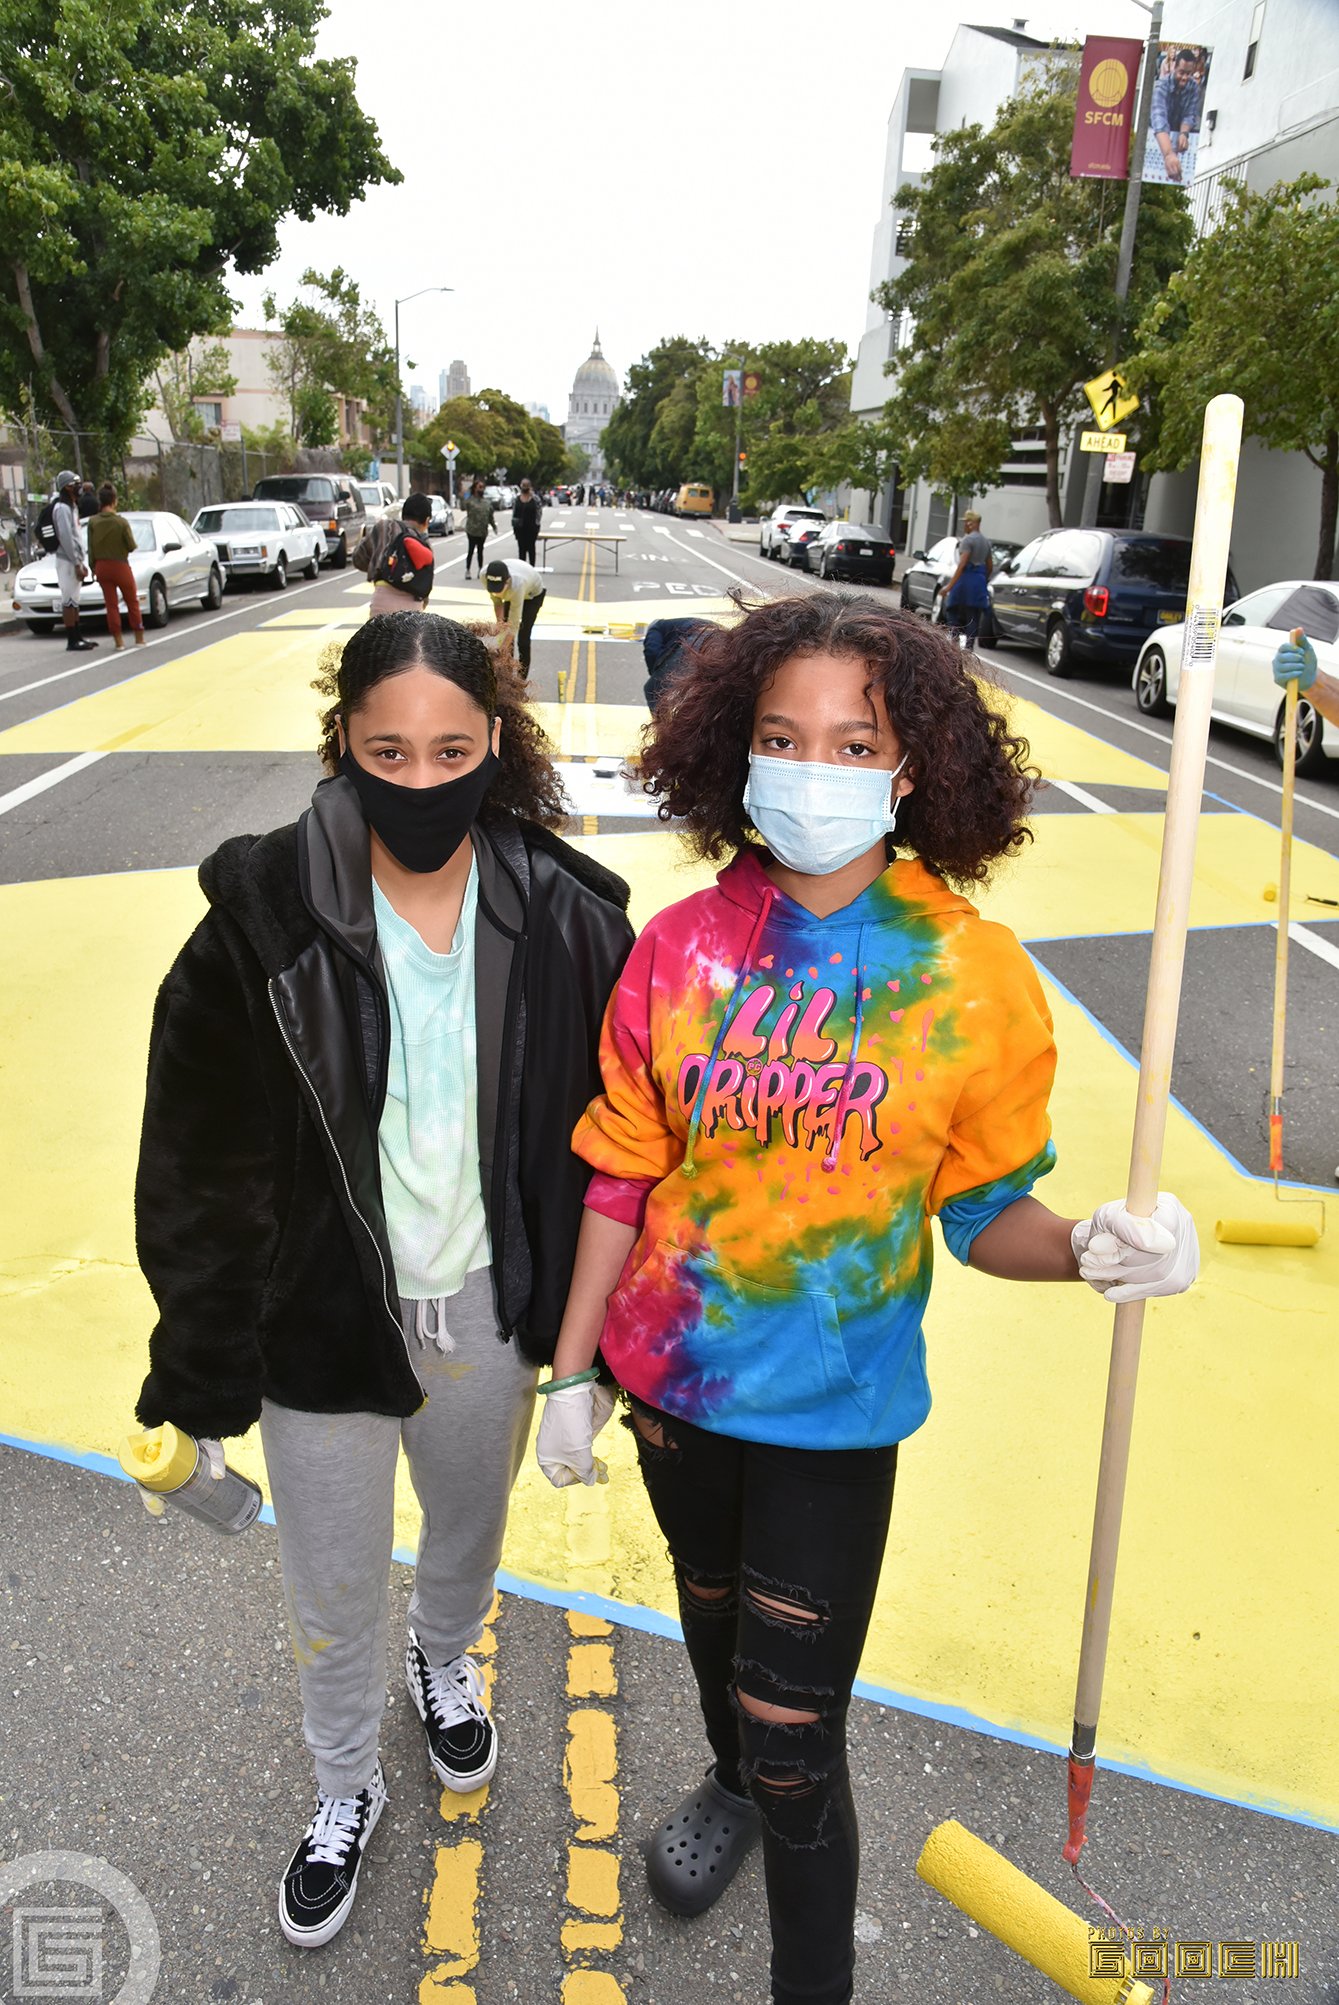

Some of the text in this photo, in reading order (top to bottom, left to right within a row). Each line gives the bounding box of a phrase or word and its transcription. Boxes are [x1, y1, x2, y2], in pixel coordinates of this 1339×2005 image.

[1084, 111, 1124, 126] SFCM
[1086, 436, 1120, 450] AHEAD
[632, 581, 722, 597] PED
